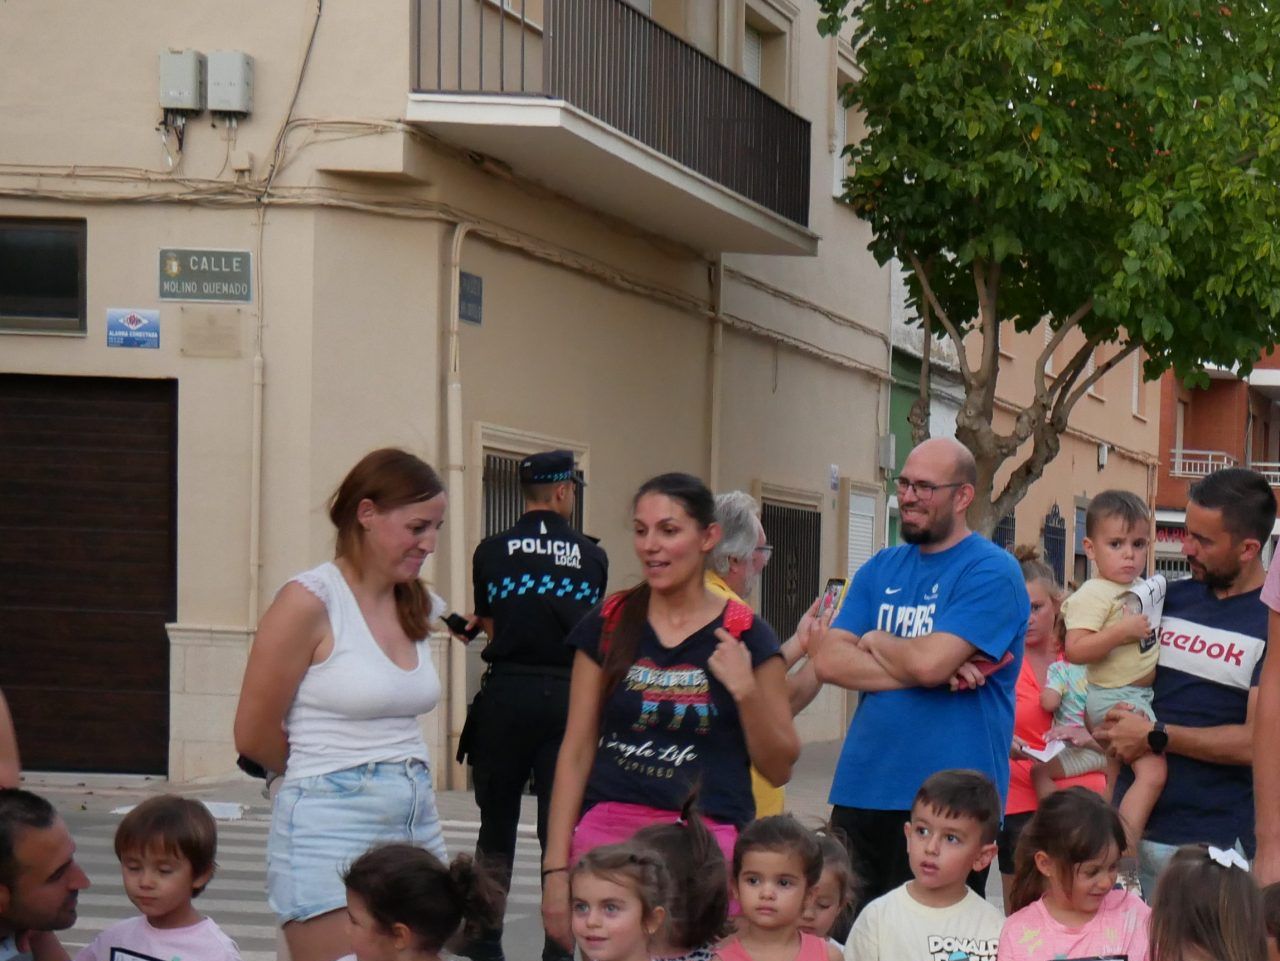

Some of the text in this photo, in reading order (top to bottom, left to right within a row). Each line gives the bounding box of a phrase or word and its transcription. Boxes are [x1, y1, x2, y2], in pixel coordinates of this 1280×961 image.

[190, 256, 242, 272] CALLE
[163, 281, 248, 296] MOLINO QUEMADO
[507, 538, 582, 560] POLICIA
[555, 554, 582, 569] LOCAL
[1158, 627, 1245, 667] eebok
[657, 744, 698, 767] Life
[927, 934, 999, 957] DONALD
